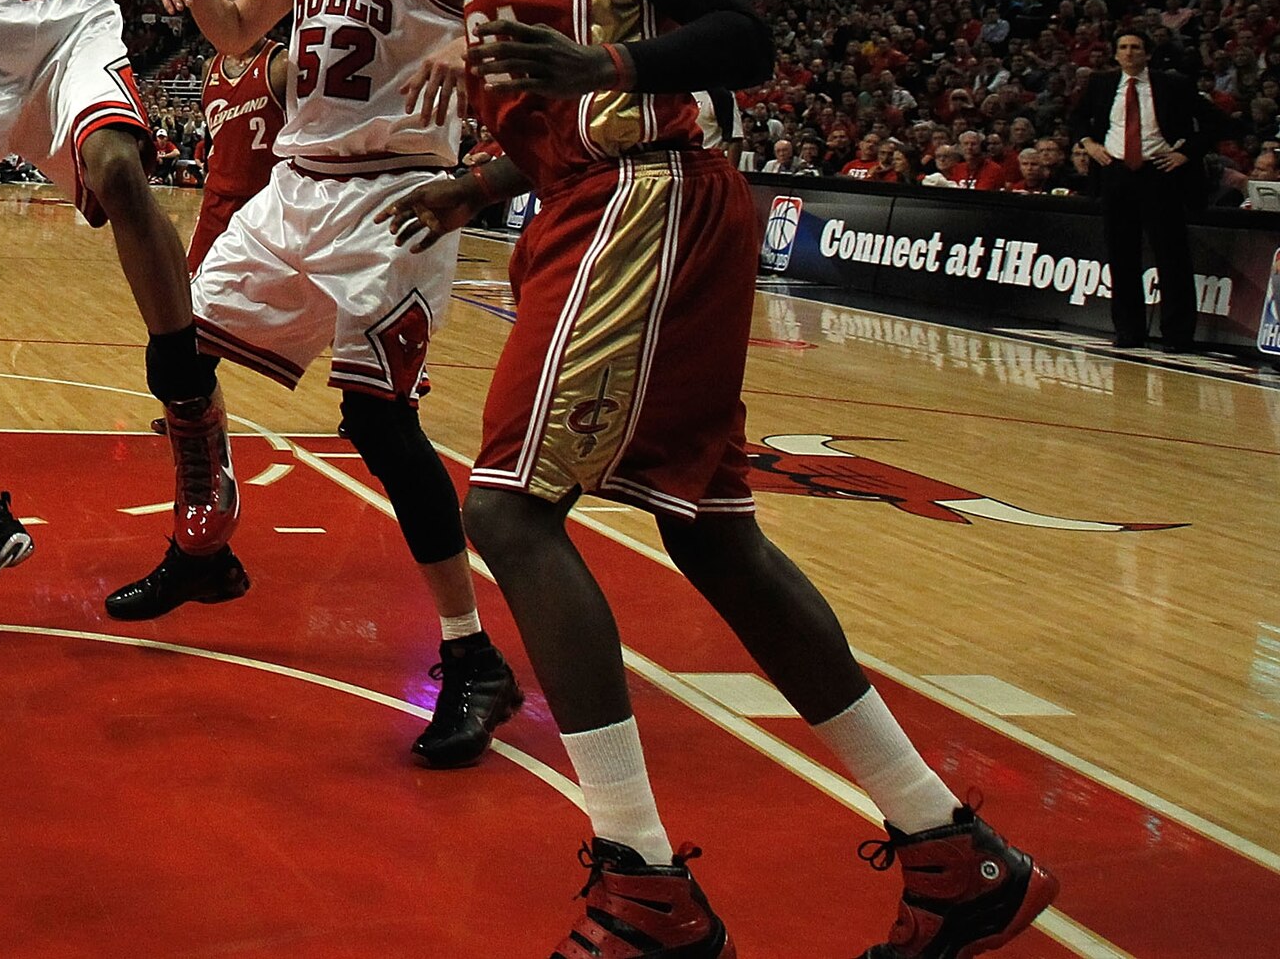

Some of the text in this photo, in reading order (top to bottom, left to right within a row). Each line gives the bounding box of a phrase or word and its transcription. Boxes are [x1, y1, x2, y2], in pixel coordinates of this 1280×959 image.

[297, 25, 377, 102] 52
[204, 95, 270, 141] CLEVELAND
[249, 117, 268, 150] 2
[819, 218, 1233, 317] Connect at iHoopscm
